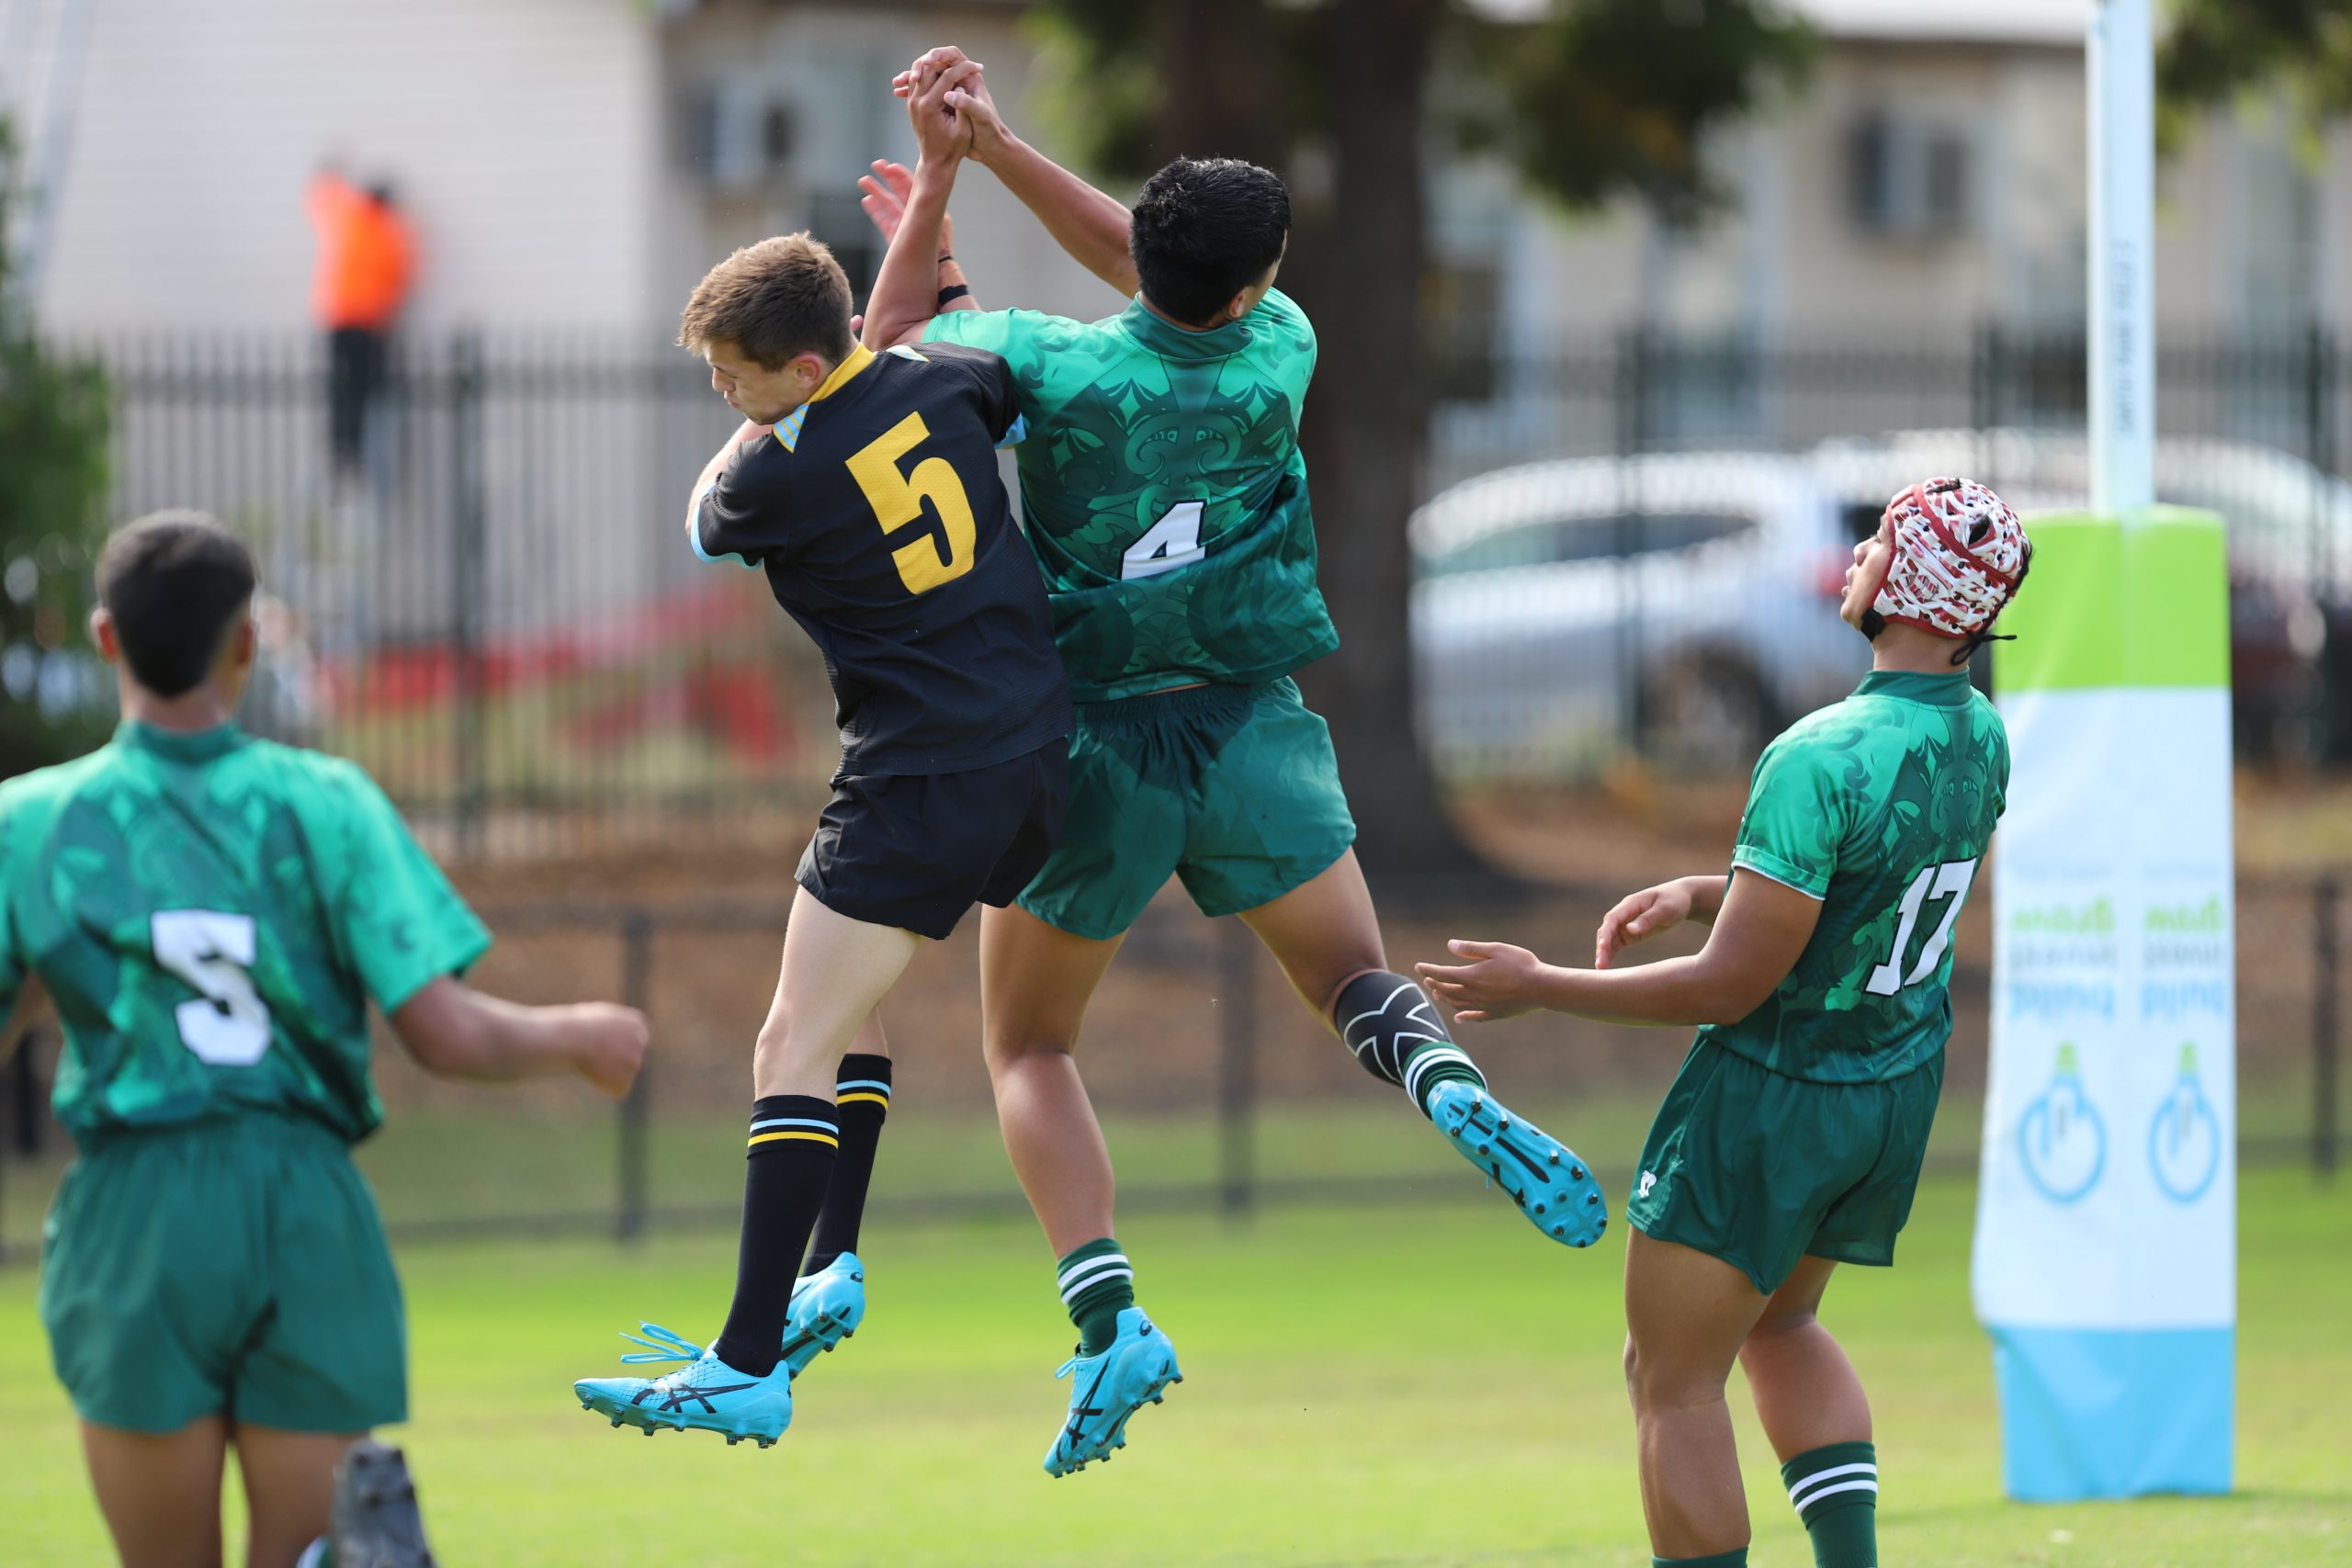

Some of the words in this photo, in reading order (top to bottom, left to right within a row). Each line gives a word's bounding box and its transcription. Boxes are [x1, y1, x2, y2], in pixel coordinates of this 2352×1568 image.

[844, 411, 977, 595] 5
[1119, 499, 1206, 581] 4
[151, 908, 272, 1066] 5
[1865, 856, 1977, 997] 17
